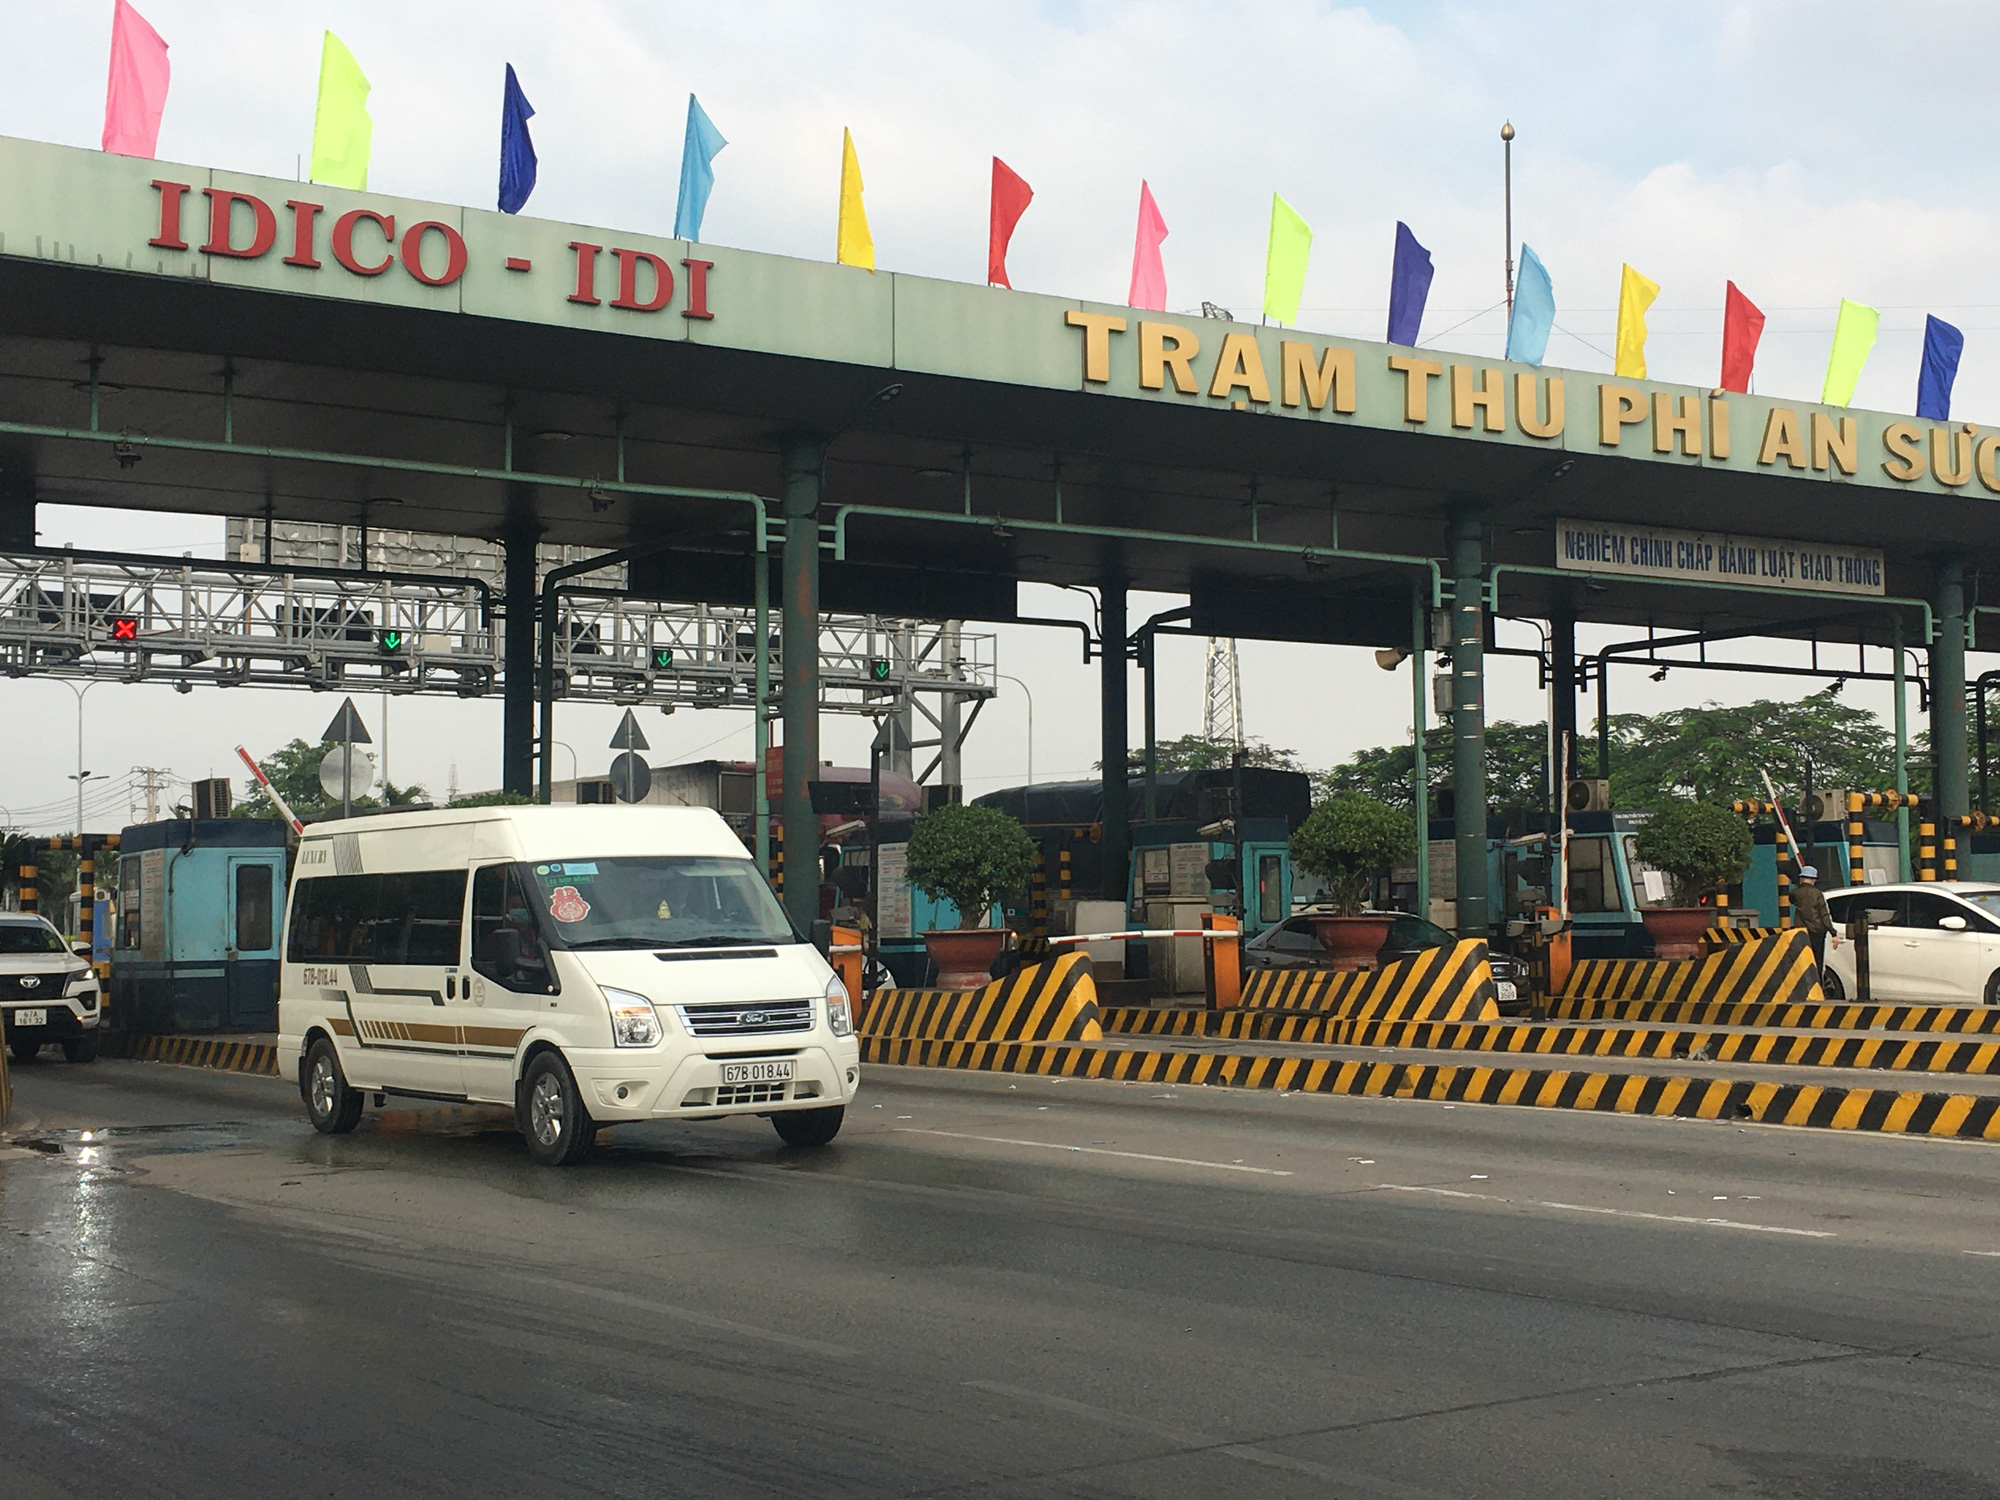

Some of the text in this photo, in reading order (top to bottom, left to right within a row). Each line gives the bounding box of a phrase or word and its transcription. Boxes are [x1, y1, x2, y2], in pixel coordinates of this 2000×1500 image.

[148, 178, 715, 320] IDICO - IDI
[1064, 310, 1356, 414] TRẠM
[1388, 355, 1565, 439] THU
[1598, 386, 1731, 460] PHÍ
[1757, 407, 1858, 475] AN
[1565, 529, 1625, 564] NGHIÊM
[1718, 540, 1756, 576] HÀNH
[1801, 553, 1833, 582] GIAO
[745, 1013, 765, 1023] Ford
